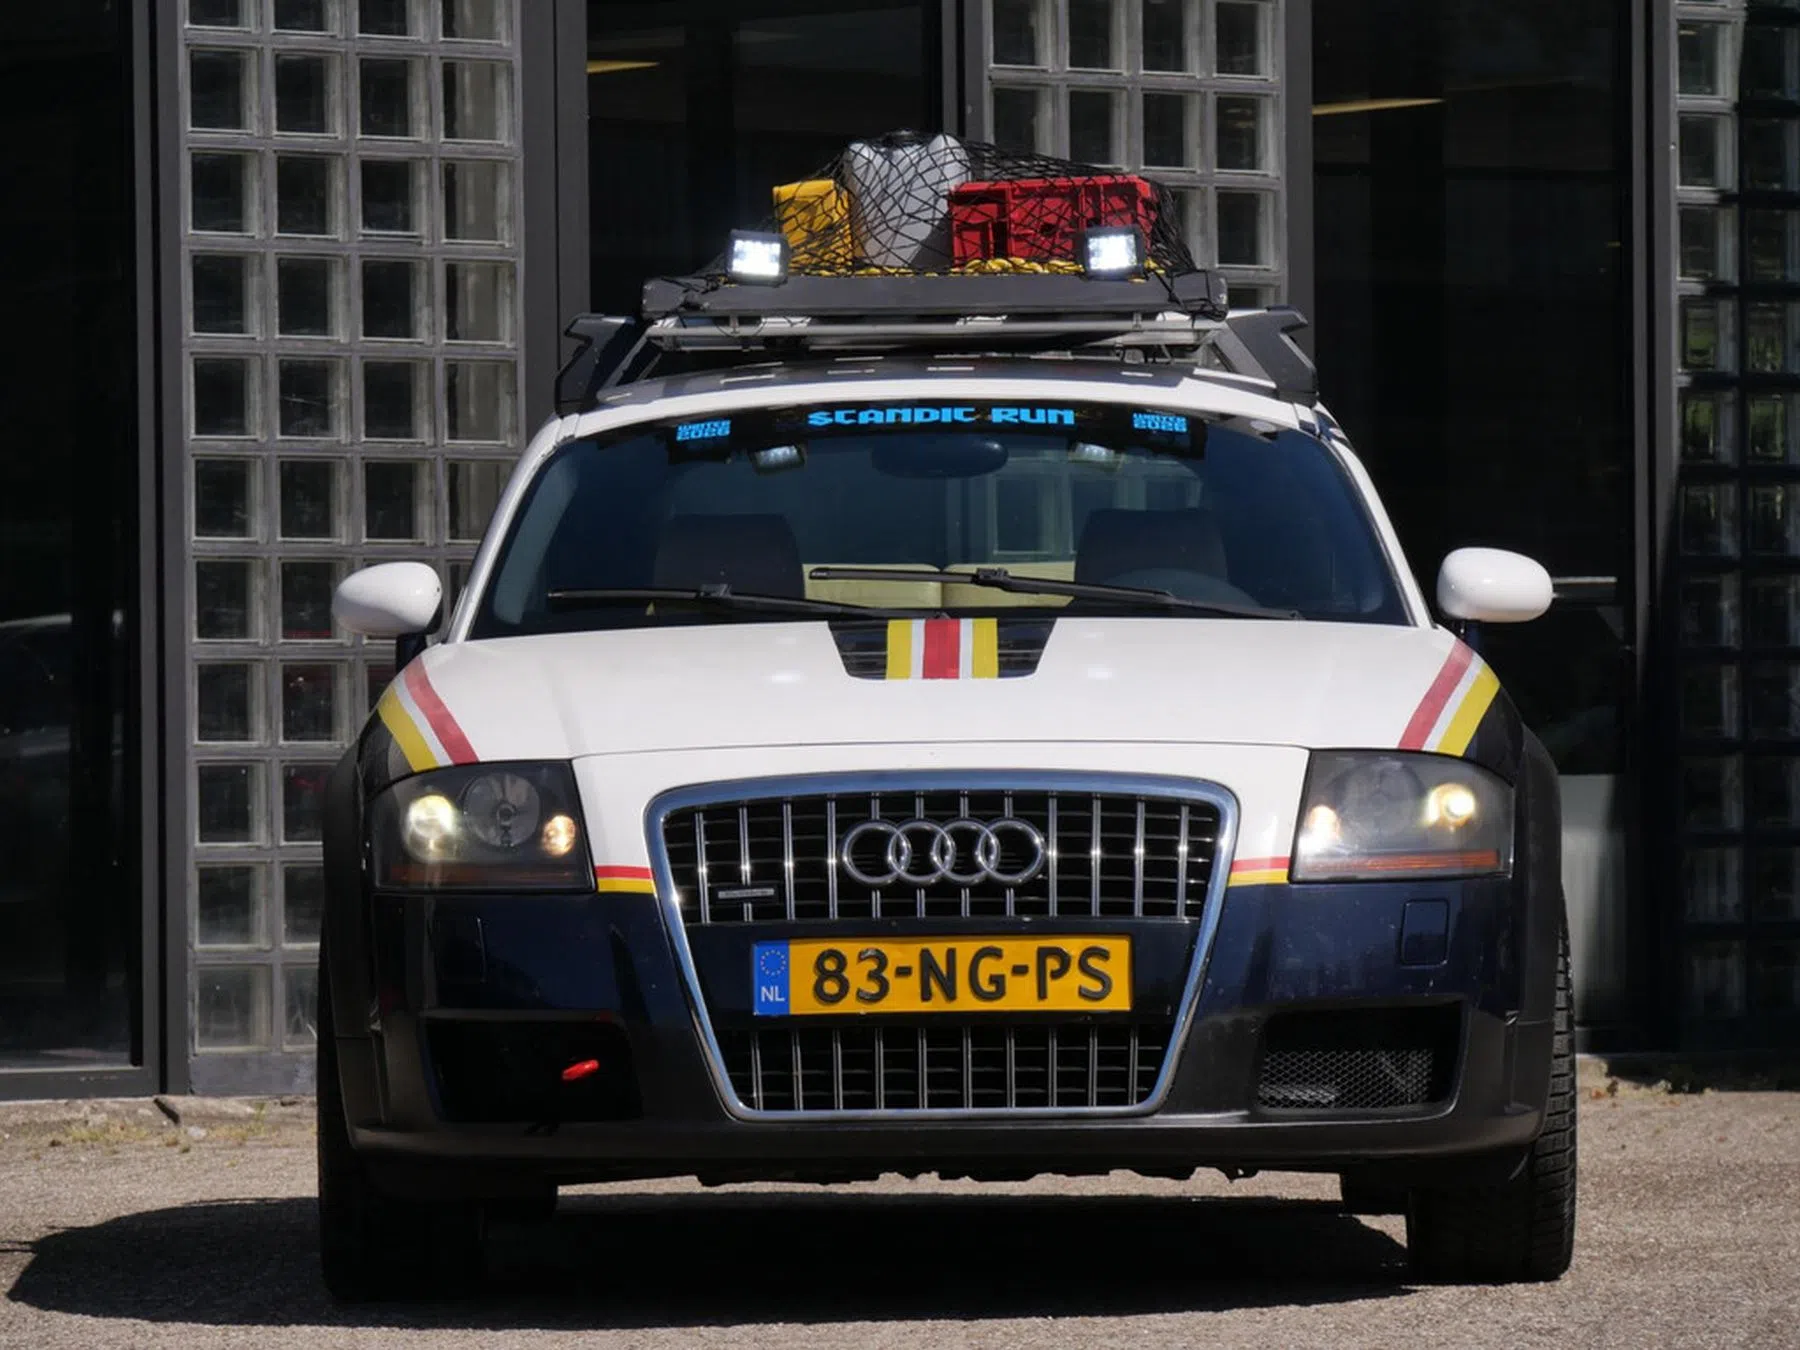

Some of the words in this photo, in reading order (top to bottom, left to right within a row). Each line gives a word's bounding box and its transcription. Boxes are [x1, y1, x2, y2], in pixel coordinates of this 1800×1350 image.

[808, 407, 976, 426] SCANDIC
[991, 407, 1075, 425] RUN
[812, 945, 1114, 1005] 83-NG-PS
[760, 985, 785, 1002] NL
